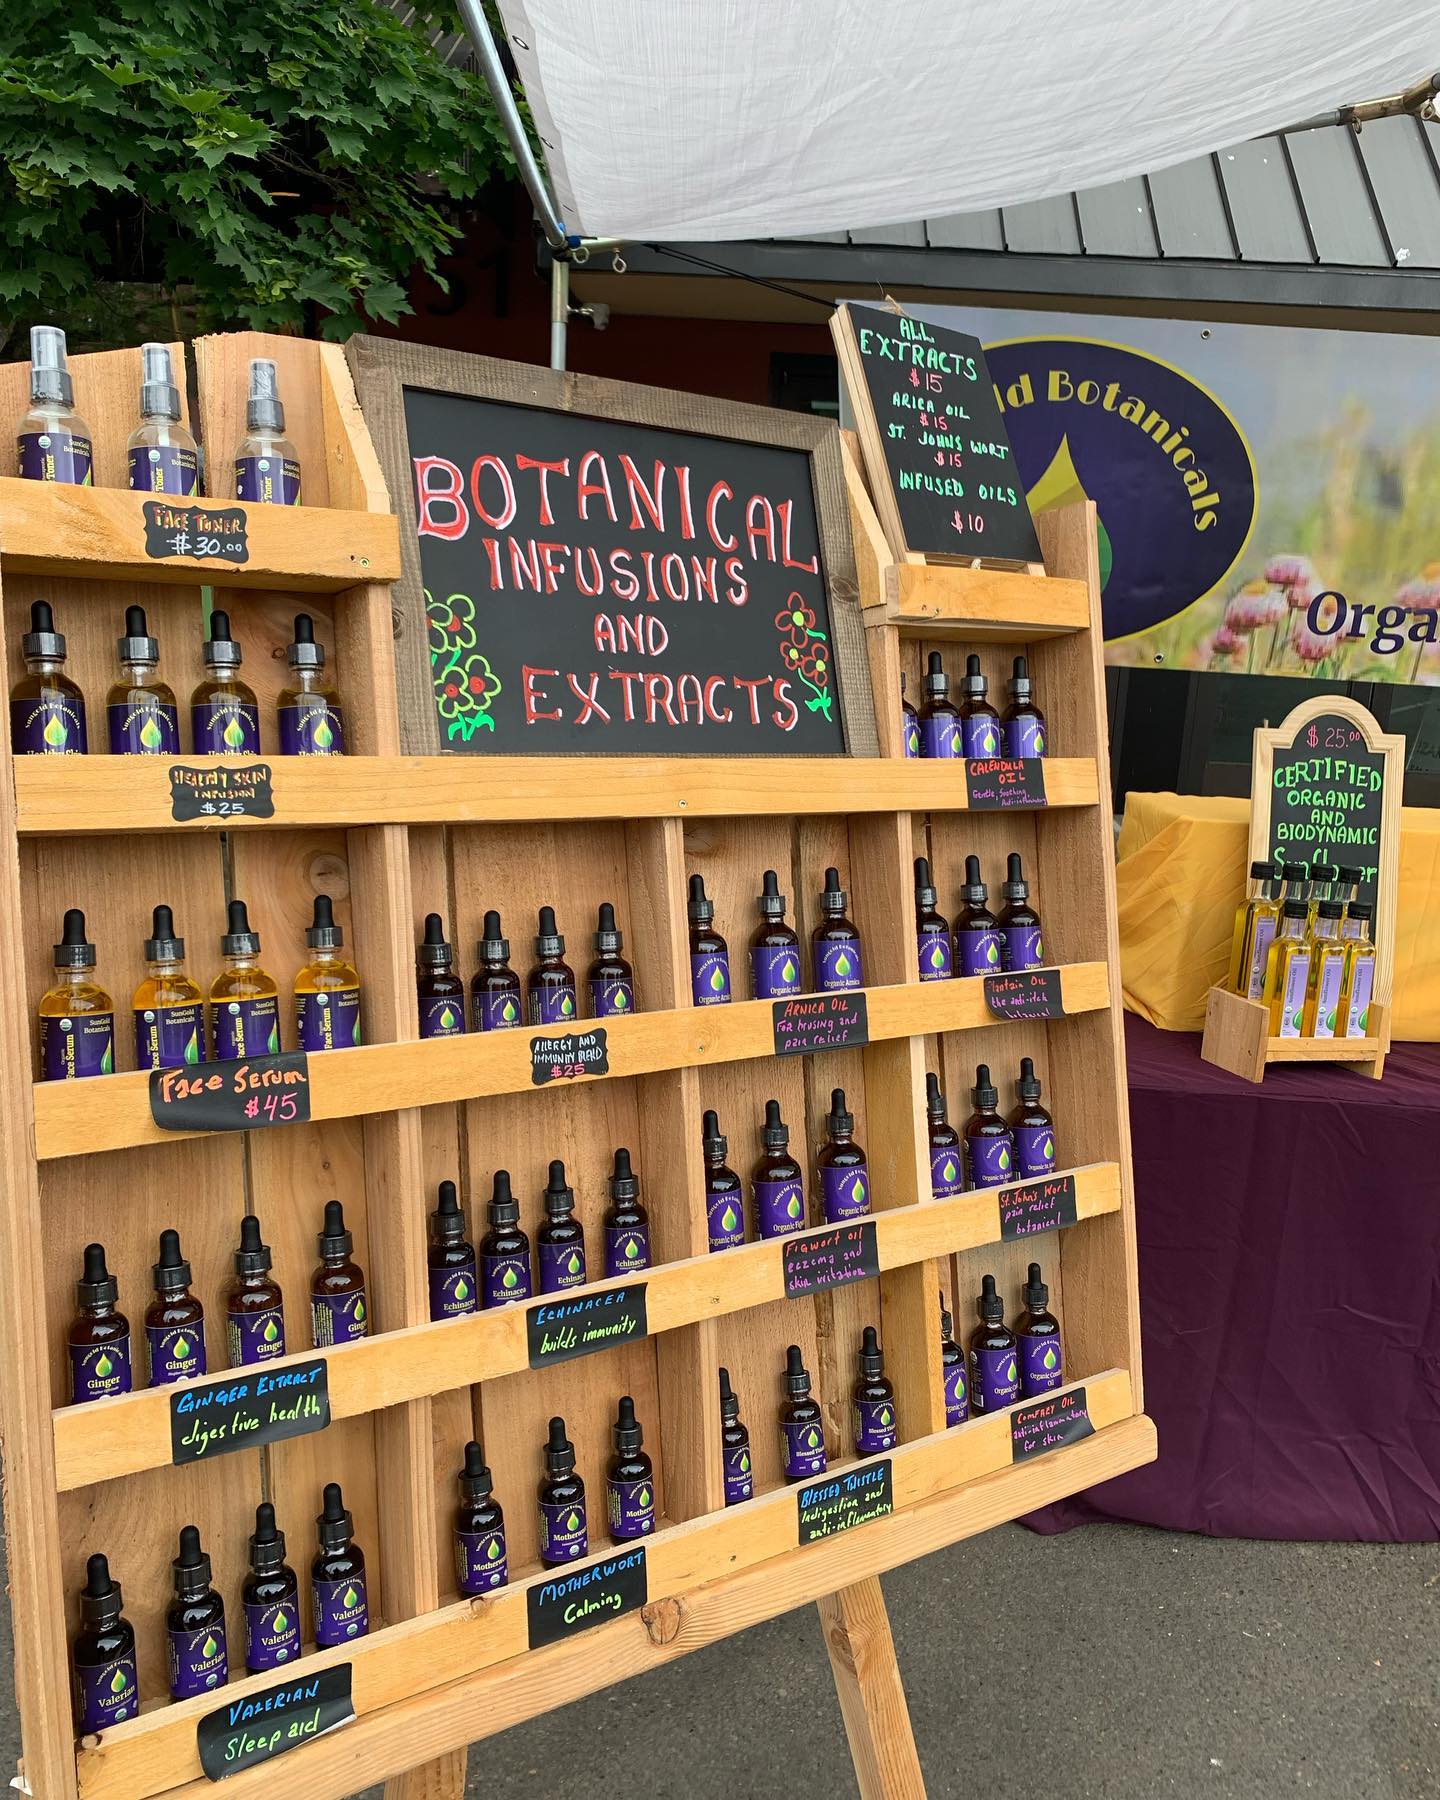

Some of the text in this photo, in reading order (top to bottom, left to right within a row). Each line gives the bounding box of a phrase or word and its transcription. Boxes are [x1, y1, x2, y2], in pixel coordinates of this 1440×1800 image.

[900, 318, 935, 343] ALL
[860, 328, 978, 382] EXTRACTS
[945, 403, 971, 420] OIL
[887, 423, 1009, 460] ST. JOHNS WORT
[1047, 369, 1220, 532] Botanicals
[899, 469, 1018, 507] INFUSED OILS
[413, 450, 819, 575] BOTANICAL
[482, 535, 749, 607] INFUSIONS
[1306, 590, 1440, 655] Orga
[594, 612, 669, 657] AND
[522, 664, 799, 731] EXTRACTS
[233, 768, 267, 786] SKIN
[970, 759, 1024, 777] CALENDULA
[998, 772, 1026, 785] OIL
[1274, 757, 1382, 792] CERTIFIED
[200, 801, 245, 816] $25
[1287, 789, 1366, 811] ORGANIC
[1311, 809, 1346, 827] AND
[1277, 822, 1378, 846] BIODYNAMIC
[784, 998, 849, 1018] ARNICA OIL
[839, 1012, 858, 1025] and
[534, 1034, 596, 1053] ALLERGY AND
[534, 1052, 575, 1064] IMMUNITY
[551, 1063, 585, 1078] $25
[160, 1068, 223, 1104] Face
[244, 1092, 298, 1122] $45
[1005, 1197, 1056, 1223] pain relief
[1016, 1211, 1061, 1234] botanical
[843, 1241, 863, 1261] and
[788, 1272, 812, 1291] skin
[540, 1314, 637, 1355] builds immunity
[165, 1357, 197, 1371] Ginger
[87, 1375, 121, 1391] Ginger
[176, 1367, 322, 1415] GINGER EXTRACT
[1061, 1396, 1075, 1409] OIL
[1024, 1433, 1064, 1452] for skin
[864, 1482, 885, 1501] and
[332, 1603, 366, 1622] Valerian
[563, 1592, 622, 1625] Calming
[261, 1627, 297, 1646] Valerian
[190, 1652, 225, 1673] Valerian
[98, 1685, 135, 1708] Valerian
[224, 1707, 321, 1761] Sleep aid
